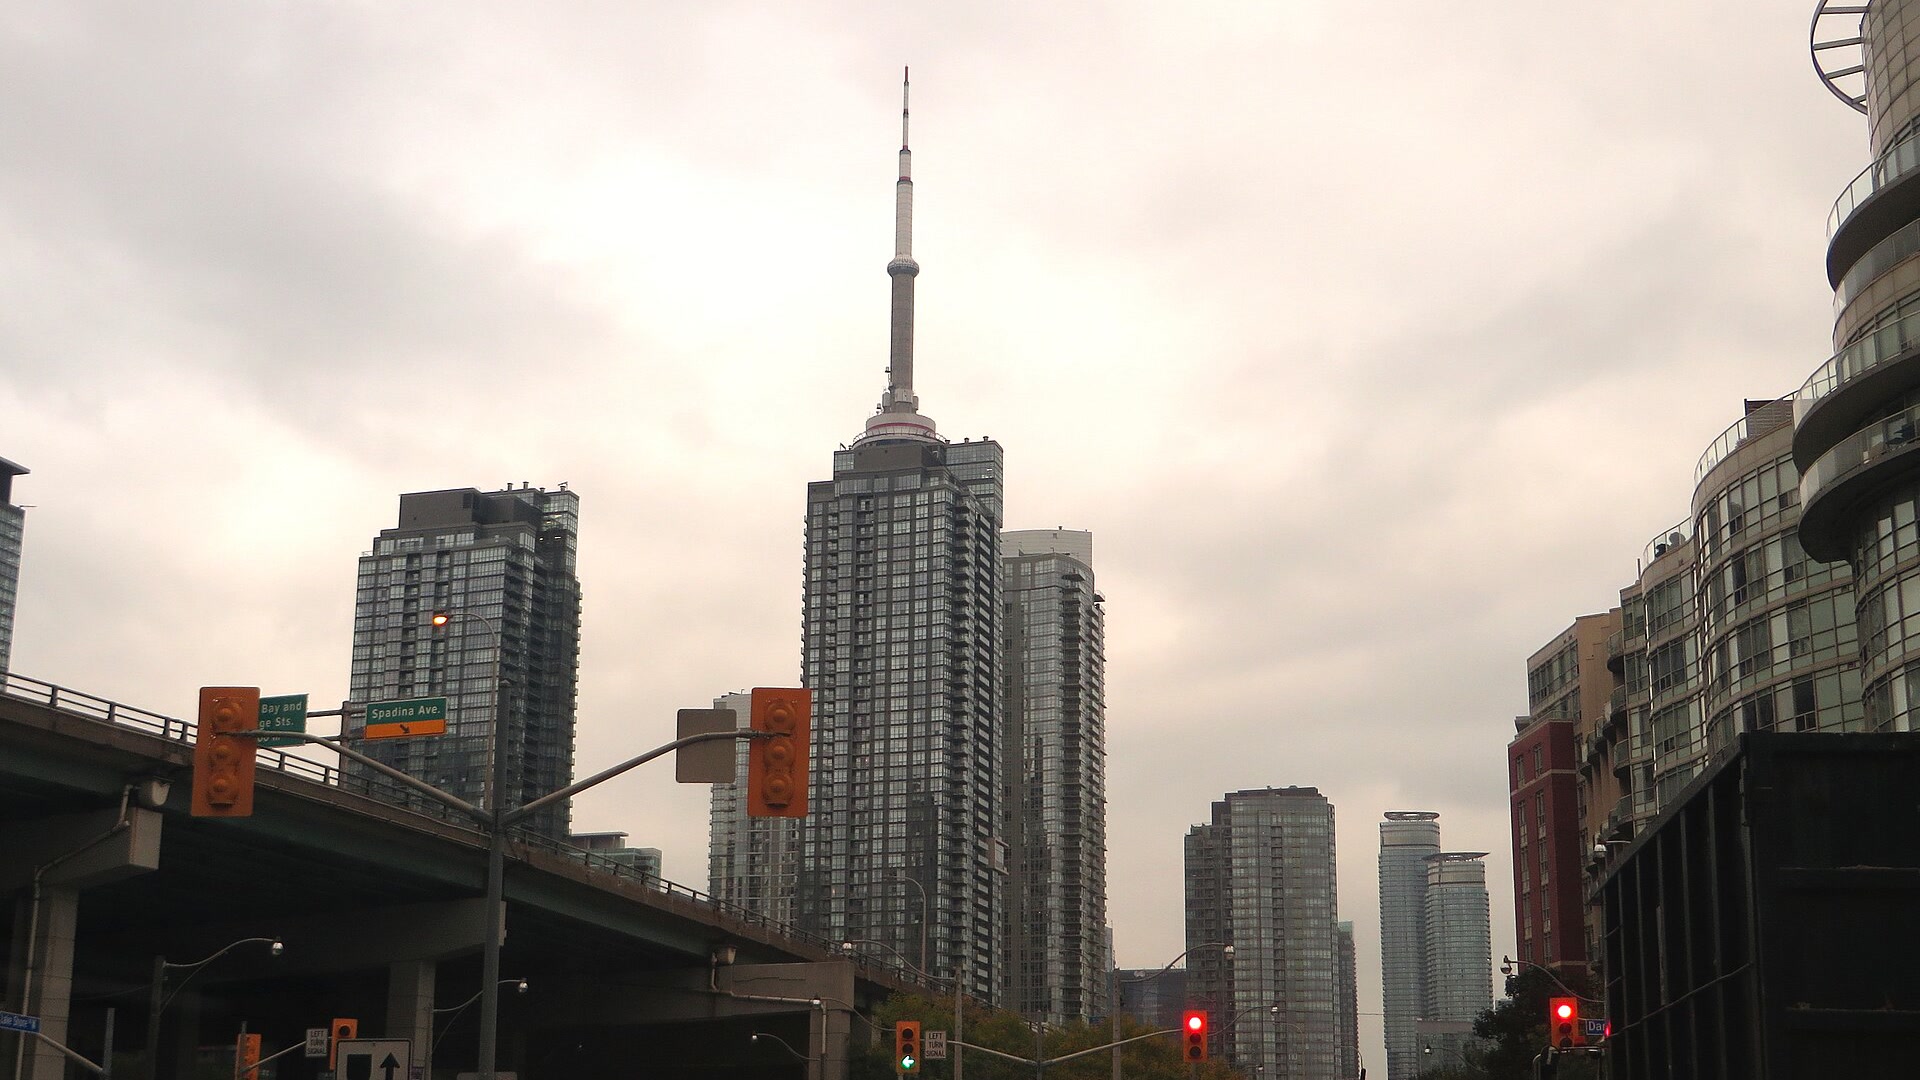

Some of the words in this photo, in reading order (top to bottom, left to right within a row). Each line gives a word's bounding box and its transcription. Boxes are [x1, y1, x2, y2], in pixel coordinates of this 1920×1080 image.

[261, 703, 281, 715] Bay
[283, 701, 302, 712] and
[372, 707, 414, 719] Spadina
[418, 705, 441, 715] Ave.
[275, 716, 295, 727] Sts.
[928, 1032, 943, 1040] LEFT
[928, 1041, 944, 1049] TURN
